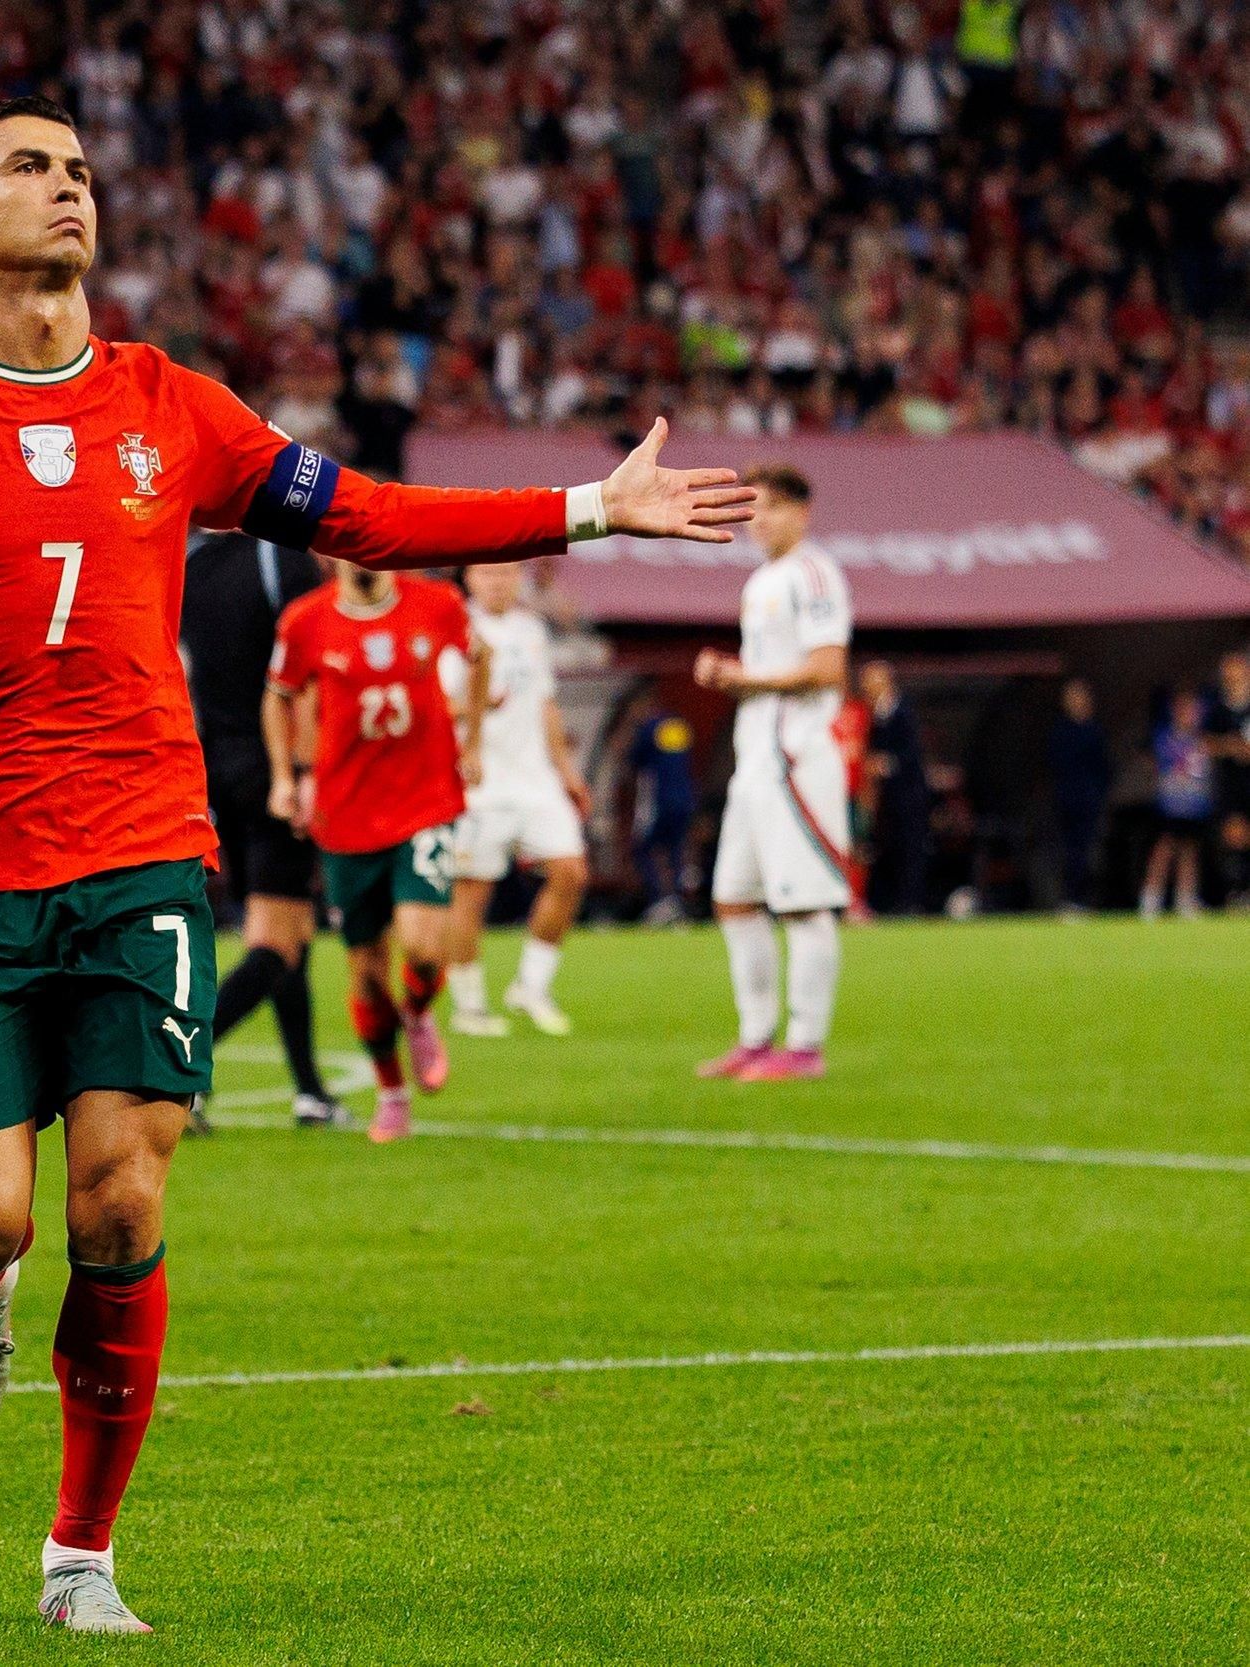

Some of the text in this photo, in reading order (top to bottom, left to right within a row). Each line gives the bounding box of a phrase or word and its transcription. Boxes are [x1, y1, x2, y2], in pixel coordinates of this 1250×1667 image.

[298, 447, 317, 486] RESP
[41, 542, 84, 645] 7
[358, 684, 413, 740] 23
[152, 914, 191, 1012] 7
